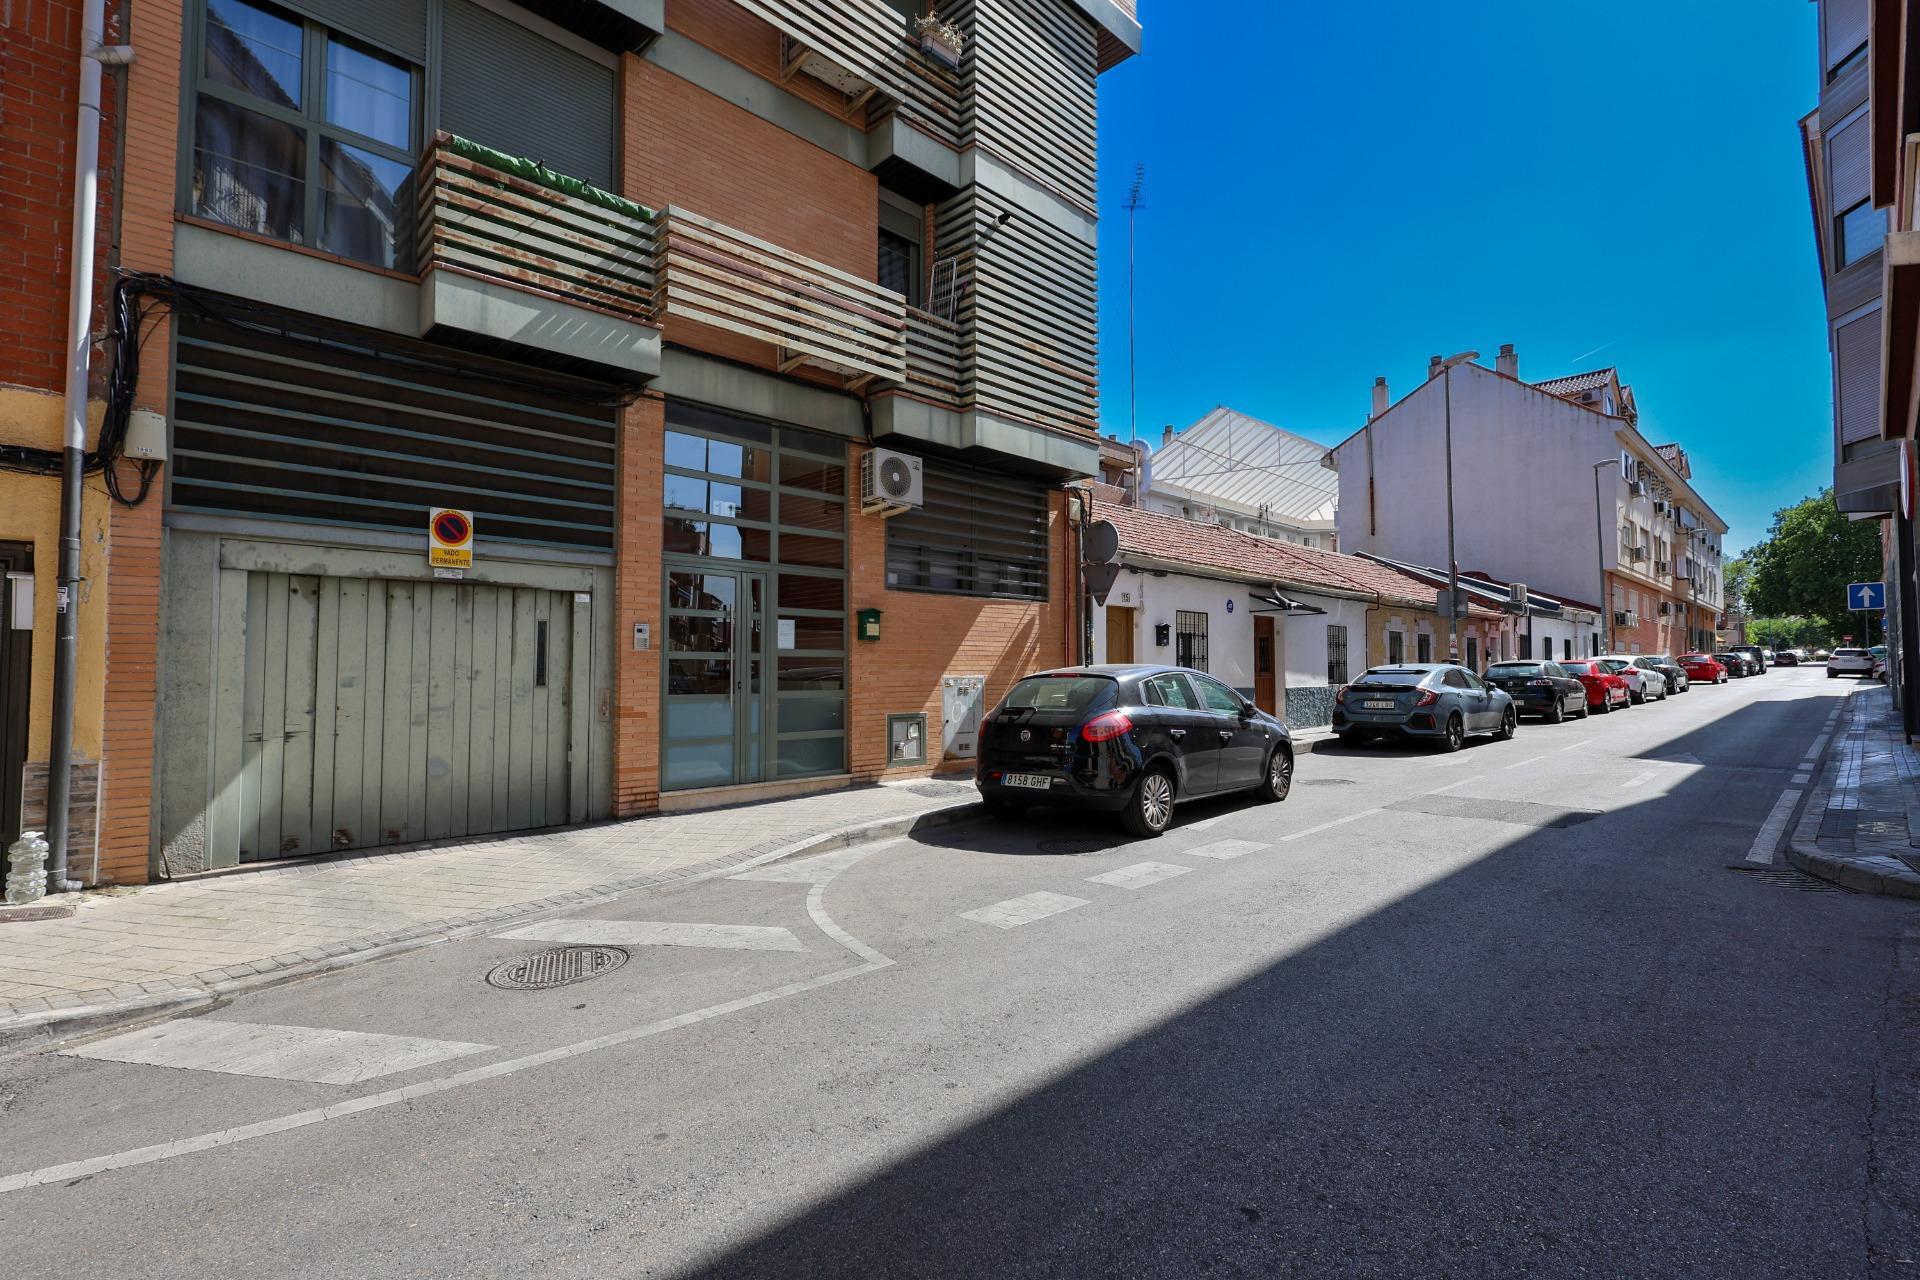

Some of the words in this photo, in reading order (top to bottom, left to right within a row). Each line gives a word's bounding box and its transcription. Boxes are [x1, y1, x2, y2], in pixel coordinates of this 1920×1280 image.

[443, 549, 460, 557] VADO
[432, 557, 470, 566] PERMANENTE
[1007, 774, 1029, 786] 8158
[1030, 776, 1049, 788] GHF
